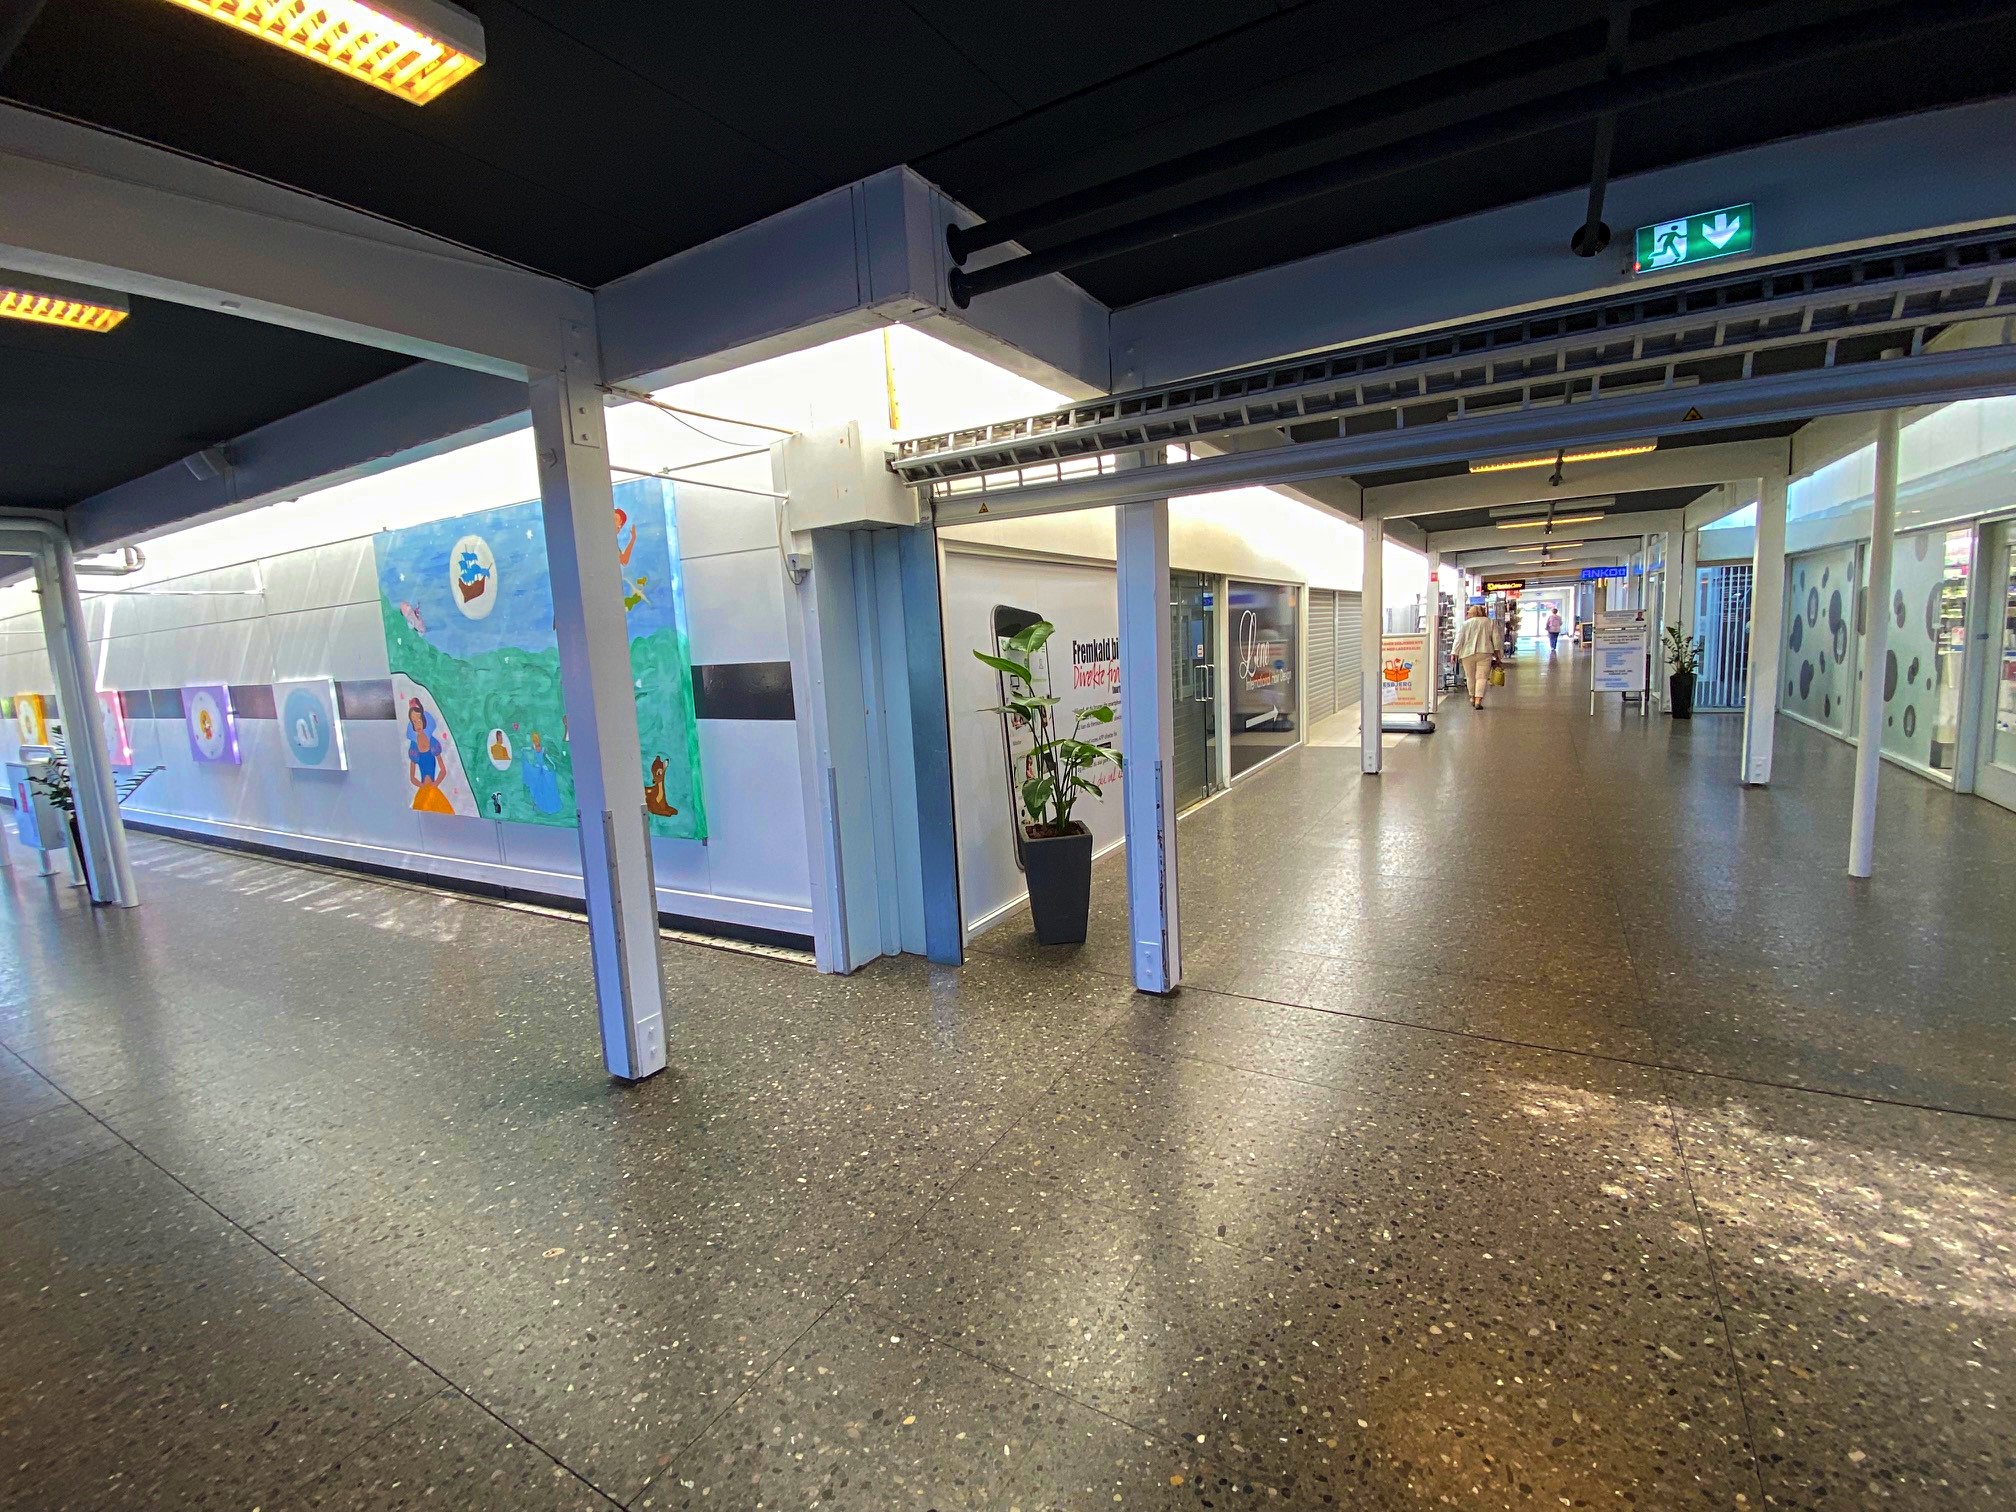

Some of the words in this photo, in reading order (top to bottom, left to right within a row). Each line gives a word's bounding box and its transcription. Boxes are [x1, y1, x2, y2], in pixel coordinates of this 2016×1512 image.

[1072, 637, 1111, 665] Fremkald
[1239, 609, 1270, 680] Lene
[1073, 661, 1105, 690] Direkte
